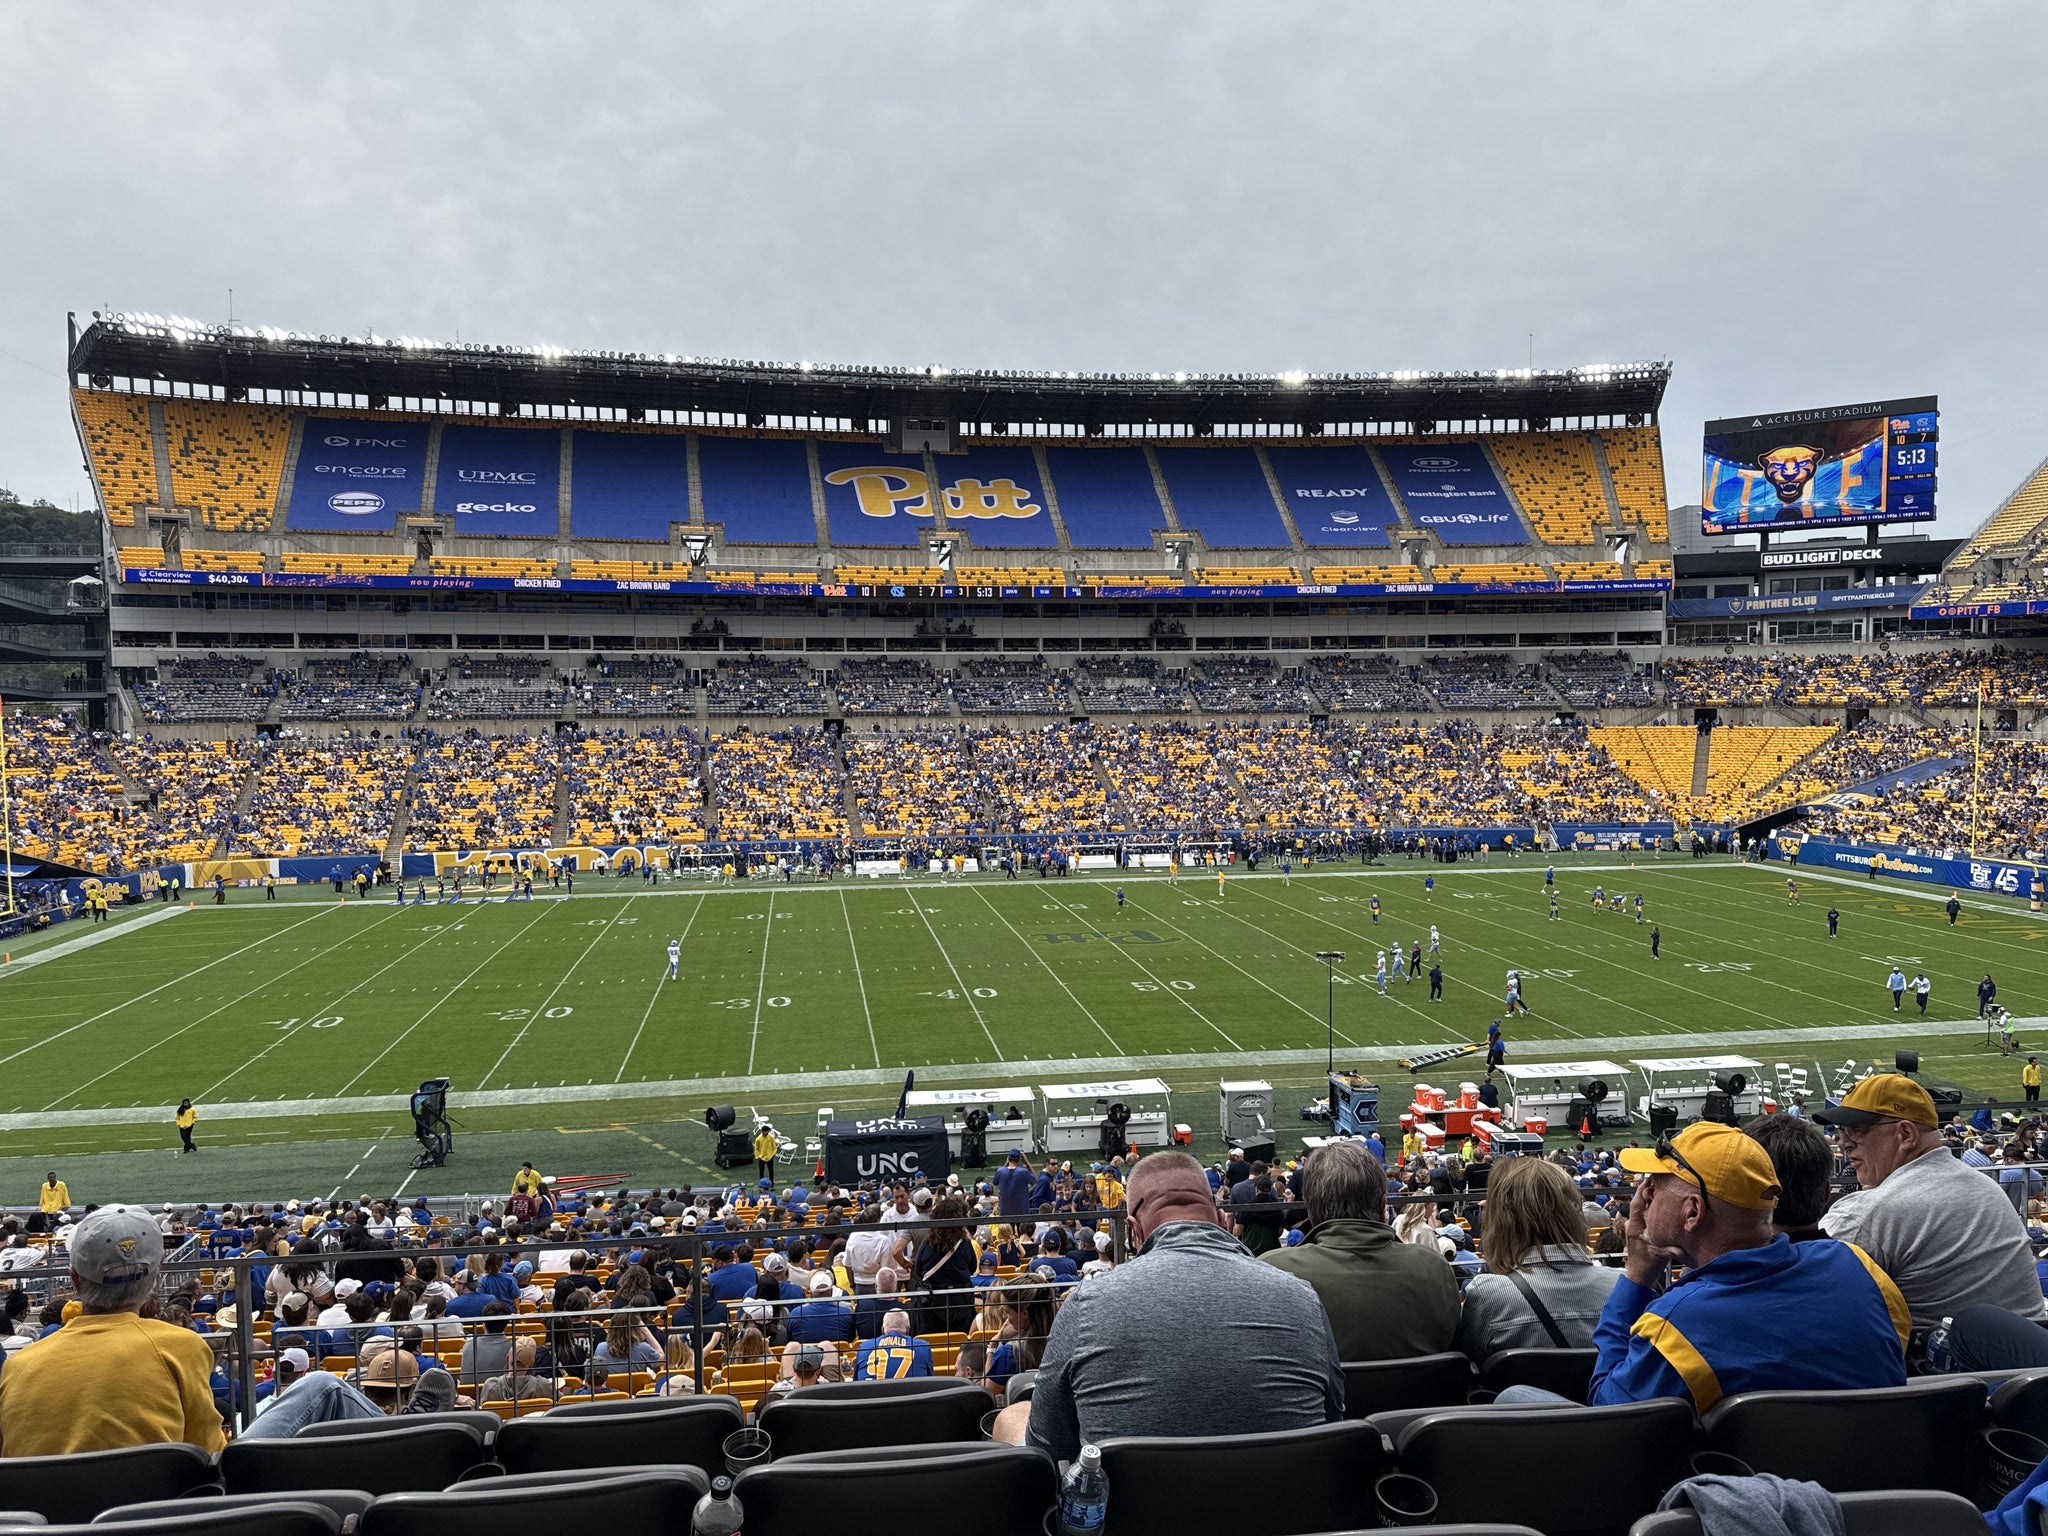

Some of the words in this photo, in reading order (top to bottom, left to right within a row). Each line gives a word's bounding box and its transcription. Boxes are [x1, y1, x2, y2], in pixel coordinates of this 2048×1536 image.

[1767, 411, 1827, 425] ACRISURE
[1832, 405, 1882, 418] STADIUM
[355, 438, 407, 448] PNC
[1896, 434, 1906, 445] 10
[1920, 432, 1927, 443] 7
[1897, 448, 1926, 466] 5:13
[314, 465, 407, 474] encore
[458, 469, 536, 482] UPMC
[824, 466, 1041, 519] Pitt
[1295, 488, 1368, 498] READY
[456, 502, 536, 514] gecko
[1420, 515, 1458, 524] GBU
[1478, 514, 1508, 524] Life
[1763, 552, 1794, 566] BUD
[1796, 551, 1838, 564] LIGHT
[1842, 548, 1883, 562] DECK
[208, 574, 249, 584] $40,304
[432, 578, 474, 588] playing:
[514, 578, 542, 588] CHICKEN
[542, 579, 562, 588] FRIED
[616, 581, 628, 590] ZAC
[630, 582, 652, 590] BROWN
[654, 582, 670, 590] BAND
[1296, 586, 1320, 594] CHICKEN
[1321, 586, 1338, 594] FRIED
[1385, 584, 1396, 592] ZAC
[1397, 584, 1417, 592] BROWN
[1418, 584, 1434, 592] BAND
[861, 586, 870, 596] 10
[930, 586, 936, 596] 7
[958, 588, 964, 596] 3
[976, 587, 992, 598] 5:13
[1832, 592, 1894, 602] @PITTPANTHERCLUB
[1746, 600, 1790, 610] PANTHER
[1792, 596, 1818, 606] CLUB
[140, 870, 160, 893] H2P
[1994, 866, 2018, 888] 45
[746, 912, 793, 920] 30
[586, 918, 639, 926] 20
[1683, 961, 1753, 973] 20
[1130, 979, 1197, 992] 50
[936, 987, 998, 1000] 40
[725, 997, 792, 1010] 30
[499, 1006, 574, 1021] 20
[275, 1015, 345, 1030] 10
[1658, 1057, 1722, 1068] UNC
[1525, 1063, 1590, 1074] UNC
[1067, 1083, 1133, 1094] UNC
[934, 1090, 1000, 1100] UNC
[1436, 1095, 1444, 1104] G
[1470, 1094, 1477, 1102] G
[857, 1152, 918, 1176] UNC
[879, 1336, 906, 1346] DONALD
[867, 1348, 915, 1380] 97
[1990, 1456, 2025, 1482] UPMC
